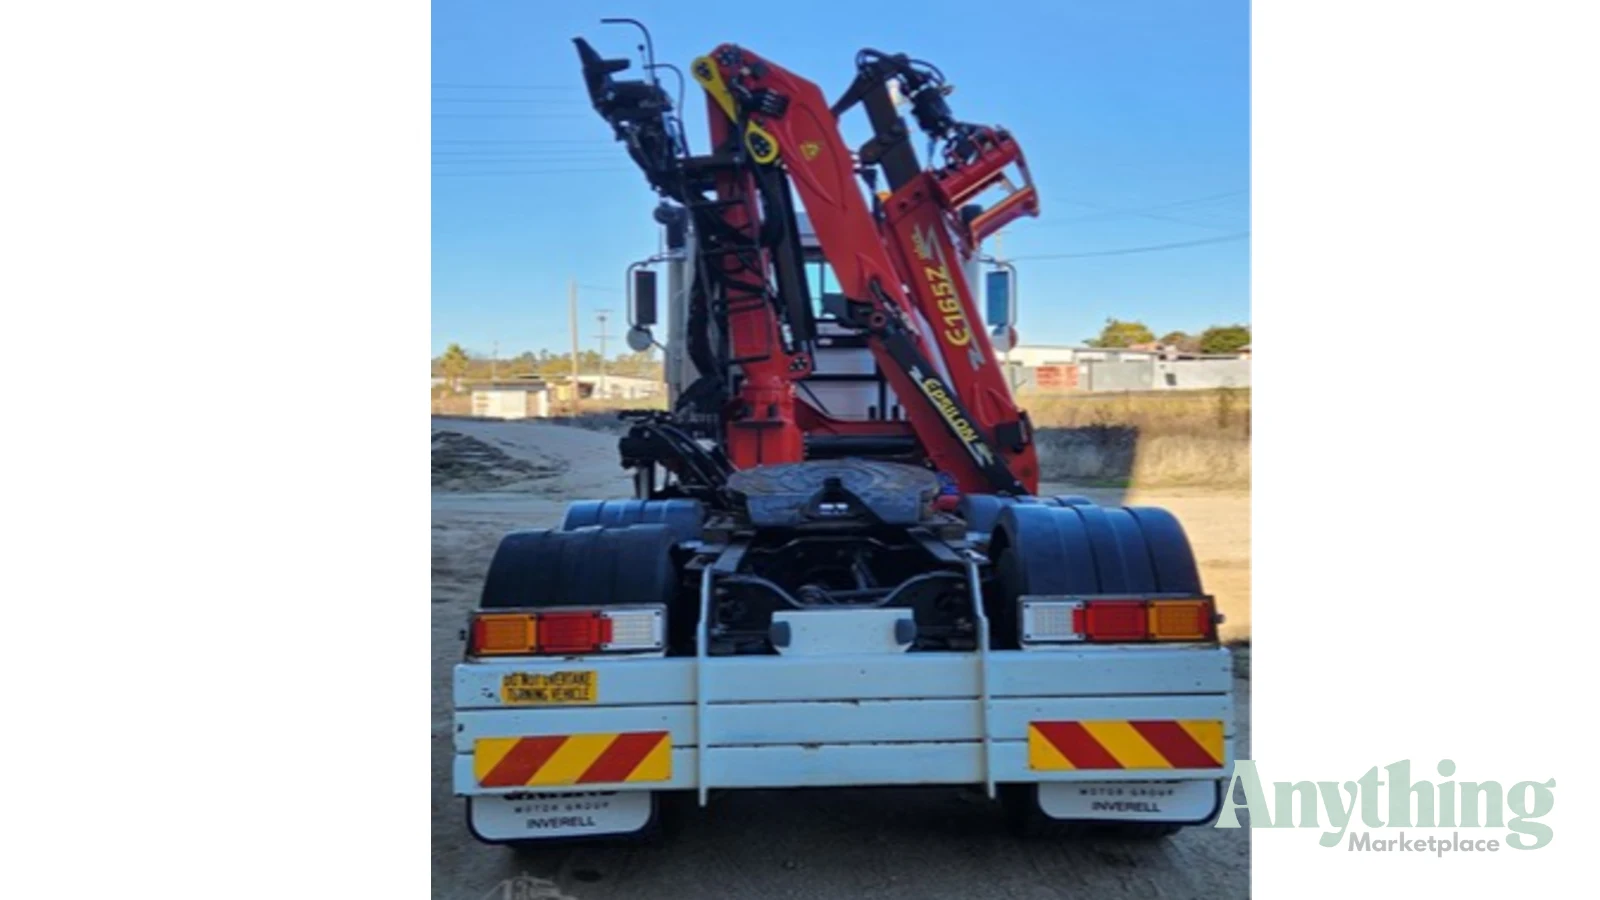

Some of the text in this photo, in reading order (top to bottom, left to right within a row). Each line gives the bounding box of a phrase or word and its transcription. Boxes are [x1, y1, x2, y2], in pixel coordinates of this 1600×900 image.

[923, 378, 979, 443] EPSILON
[551, 686, 590, 700] VEHICLE
[1080, 788, 1174, 797] MOTOR GROUP
[514, 802, 609, 813] MOTOR GROUP
[1092, 801, 1161, 812] INVERELL
[526, 816, 596, 828] INVERELL
